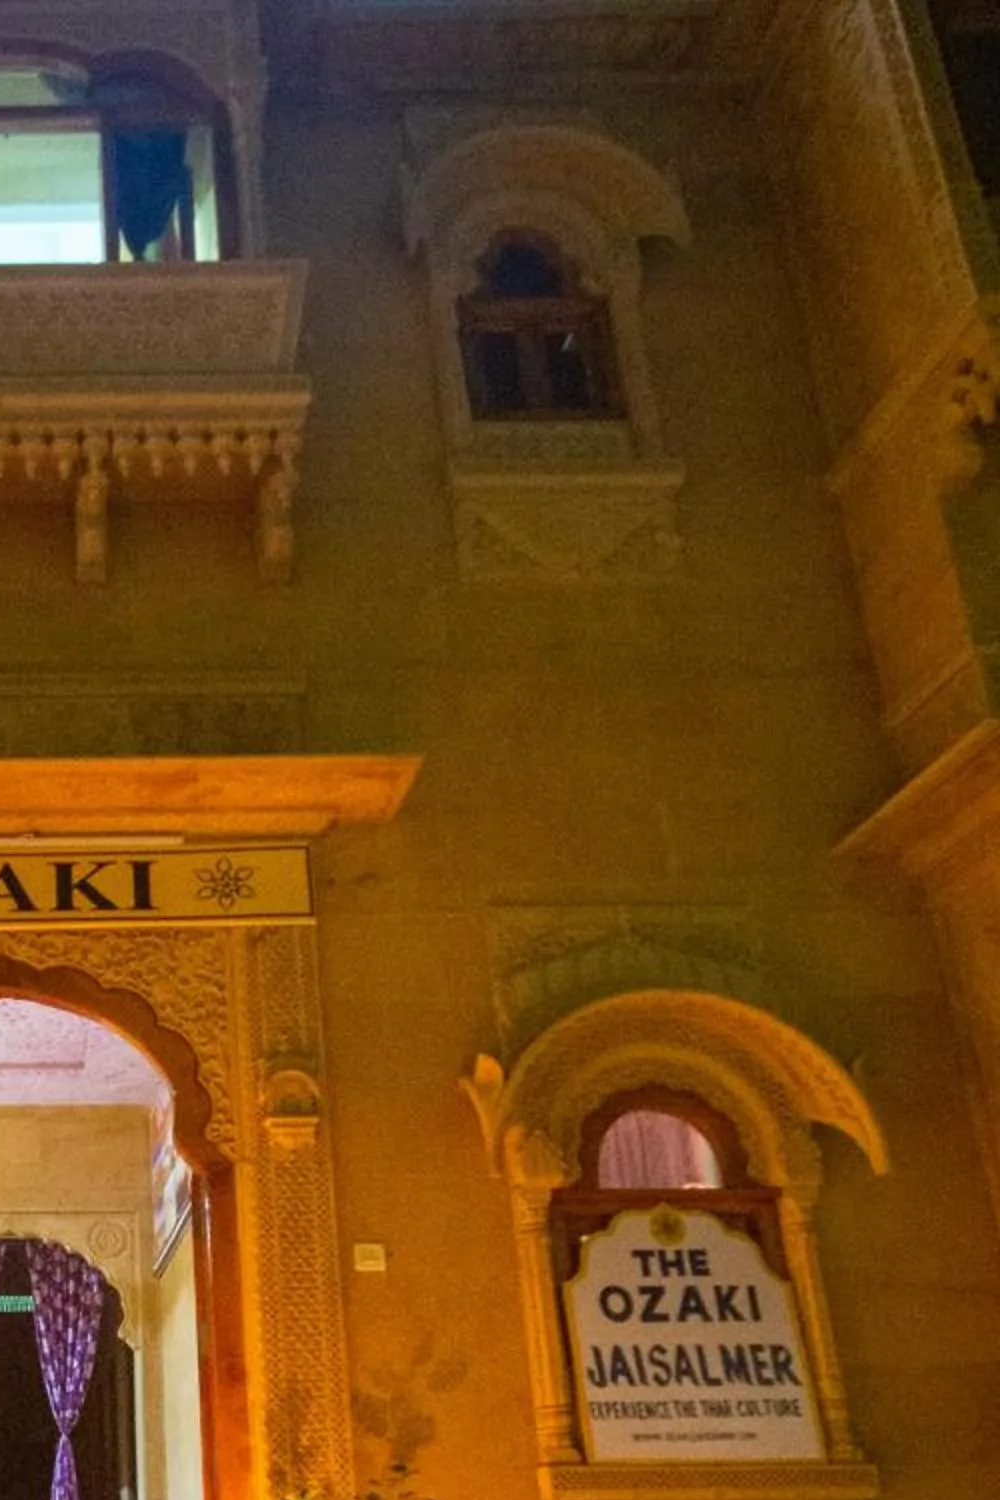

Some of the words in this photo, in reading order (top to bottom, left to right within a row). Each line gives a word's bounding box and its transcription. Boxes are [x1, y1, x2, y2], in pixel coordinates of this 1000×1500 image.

[632, 1249, 711, 1277] THE
[599, 1285, 762, 1323] OZAKI
[586, 1344, 803, 1388] JAISALMER
[589, 1401, 672, 1420] EXPERIENCE
[673, 1400, 699, 1418] THE
[736, 1398, 803, 1418] CULTURE
